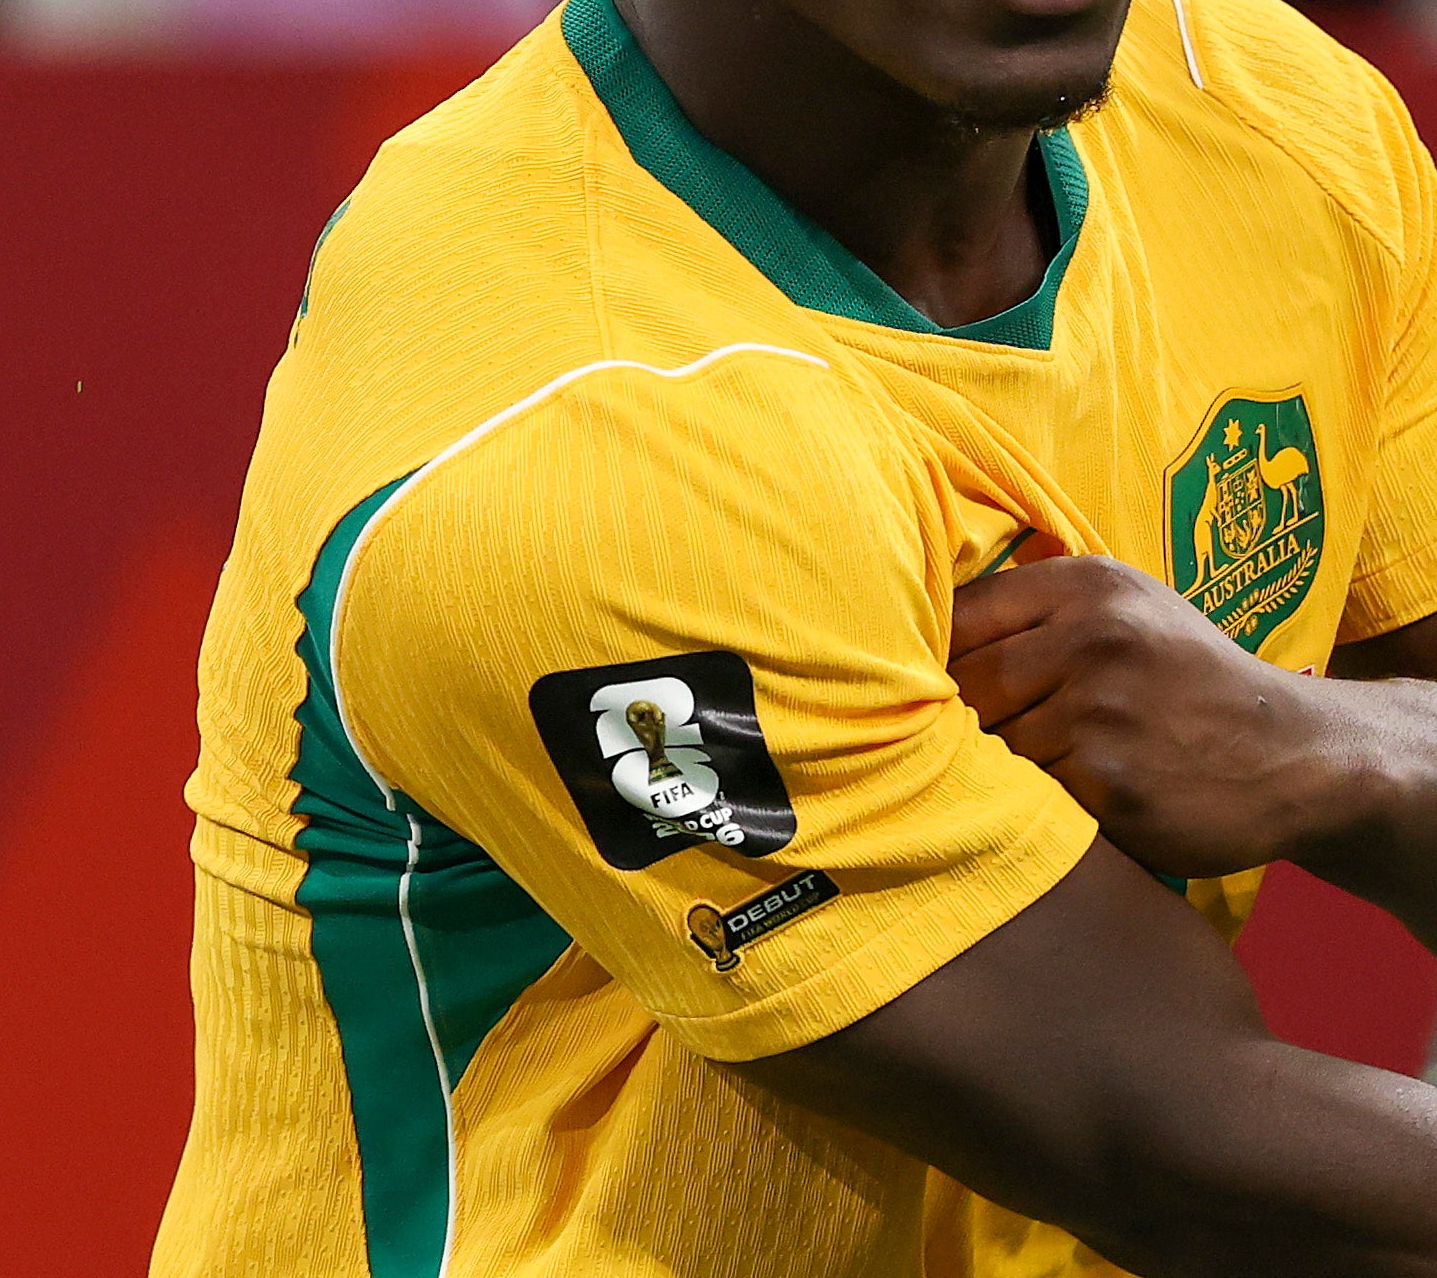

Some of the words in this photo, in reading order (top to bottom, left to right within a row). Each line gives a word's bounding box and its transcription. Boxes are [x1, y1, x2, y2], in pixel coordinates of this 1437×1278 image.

[1202, 533, 1301, 616] AUSTRALIA
[650, 782, 695, 808] FIFA
[700, 807, 733, 829] CUP
[727, 874, 815, 933] DEBUT
